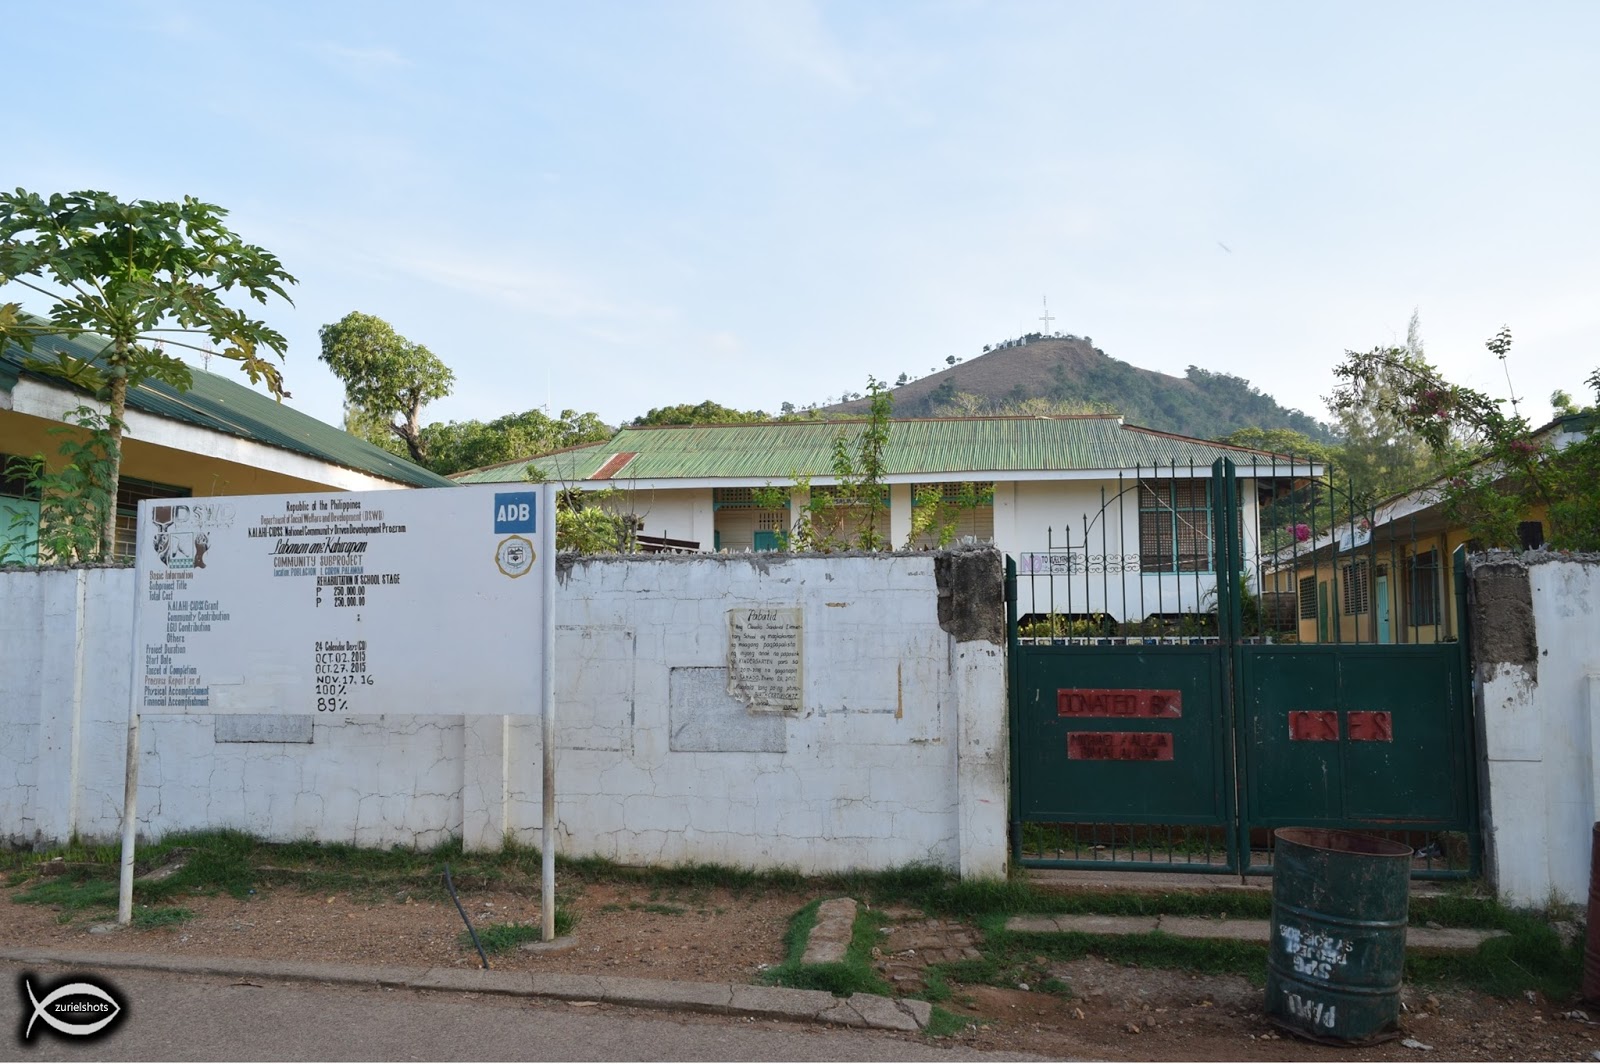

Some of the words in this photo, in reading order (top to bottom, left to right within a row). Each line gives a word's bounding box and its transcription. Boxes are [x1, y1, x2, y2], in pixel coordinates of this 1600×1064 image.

[287, 501, 309, 513] Republic
[312, 500, 316, 510] of
[330, 499, 361, 512] Philippines
[261, 514, 285, 526] Department
[290, 513, 303, 523] Social
[304, 512, 321, 523] Welfare
[322, 512, 330, 522] and
[331, 511, 361, 524] Development
[363, 510, 384, 521] (DSWD)
[497, 504, 530, 522] ADB
[285, 526, 304, 536] National
[304, 524, 334, 536] Community
[334, 524, 349, 534] Driven
[350, 523, 381, 536] Development
[382, 522, 406, 533] Program
[268, 538, 310, 555] Labanan
[309, 542, 325, 554] ang
[324, 536, 368, 557] Kahirapan
[274, 556, 316, 567] COMMUNITY
[320, 555, 362, 566] SUBPROJECT
[149, 570, 164, 580] Basic
[165, 570, 193, 580] Information
[291, 568, 316, 576] POBLACION
[342, 566, 364, 574] PALAWAN
[149, 580, 174, 591] Subproject
[176, 580, 187, 590] Title
[317, 576, 353, 586] REHABILITATION
[354, 575, 359, 584] OF
[360, 575, 380, 584] SCHOOL
[382, 574, 400, 584] STAGE
[149, 591, 160, 600] Total
[162, 590, 173, 600] Cost
[316, 587, 322, 596] P
[168, 601, 188, 611] KALAHI
[205, 600, 218, 610] Grant
[316, 597, 322, 608] P
[168, 612, 196, 621] Community
[198, 611, 230, 621] Contribution
[747, 609, 777, 621] Pabatid
[167, 622, 177, 632] LGU
[179, 622, 210, 632] Contribution
[167, 633, 185, 642] Others
[146, 644, 162, 654] Project
[164, 644, 186, 653] Duration
[315, 642, 323, 652] 24
[325, 641, 345, 651] Calendar
[146, 655, 159, 664] Start
[160, 655, 171, 664] Date
[351, 651, 366, 662] 2015
[170, 665, 197, 677] Completion
[351, 662, 366, 673] 2015
[168, 675, 186, 687] Report
[361, 674, 374, 685] 16
[144, 685, 167, 696] Physical
[168, 685, 209, 698] Accomplishment
[316, 684, 346, 695] 100%
[144, 696, 166, 706] Financial
[168, 696, 209, 710] Accomplishment
[318, 698, 348, 712] 89%
[1060, 694, 1137, 714] DONATED
